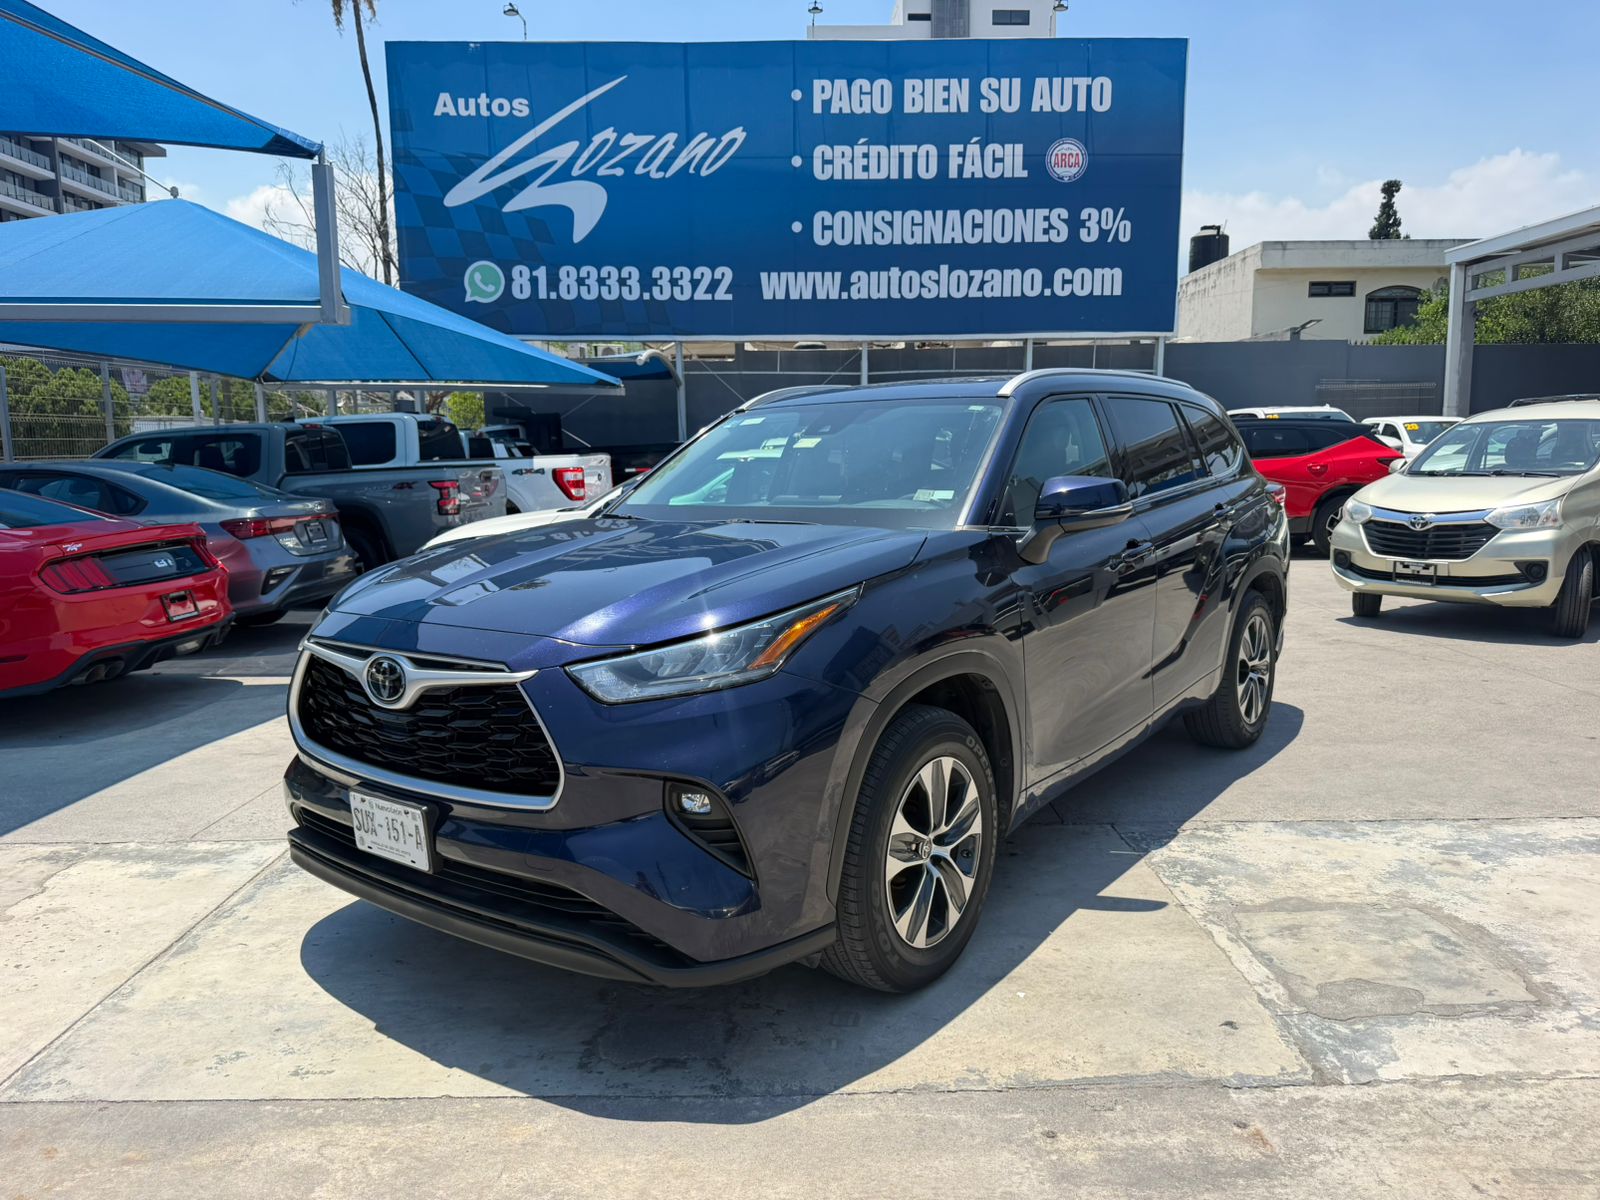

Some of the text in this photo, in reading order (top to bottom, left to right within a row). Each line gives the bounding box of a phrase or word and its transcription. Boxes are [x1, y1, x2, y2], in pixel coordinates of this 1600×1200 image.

[433, 92, 530, 118] Autos
[812, 76, 1113, 115] PAGO BIEN SU AUTO
[813, 137, 1029, 181] CRÉDITO FÁCIL
[1053, 152, 1081, 169] ARCA
[813, 206, 1132, 246] CONSIGNACIONES 3%
[511, 265, 734, 301] 81.8333.3322
[760, 264, 1123, 301] www.autoslozano.com
[965, 735, 993, 784] OPEN
